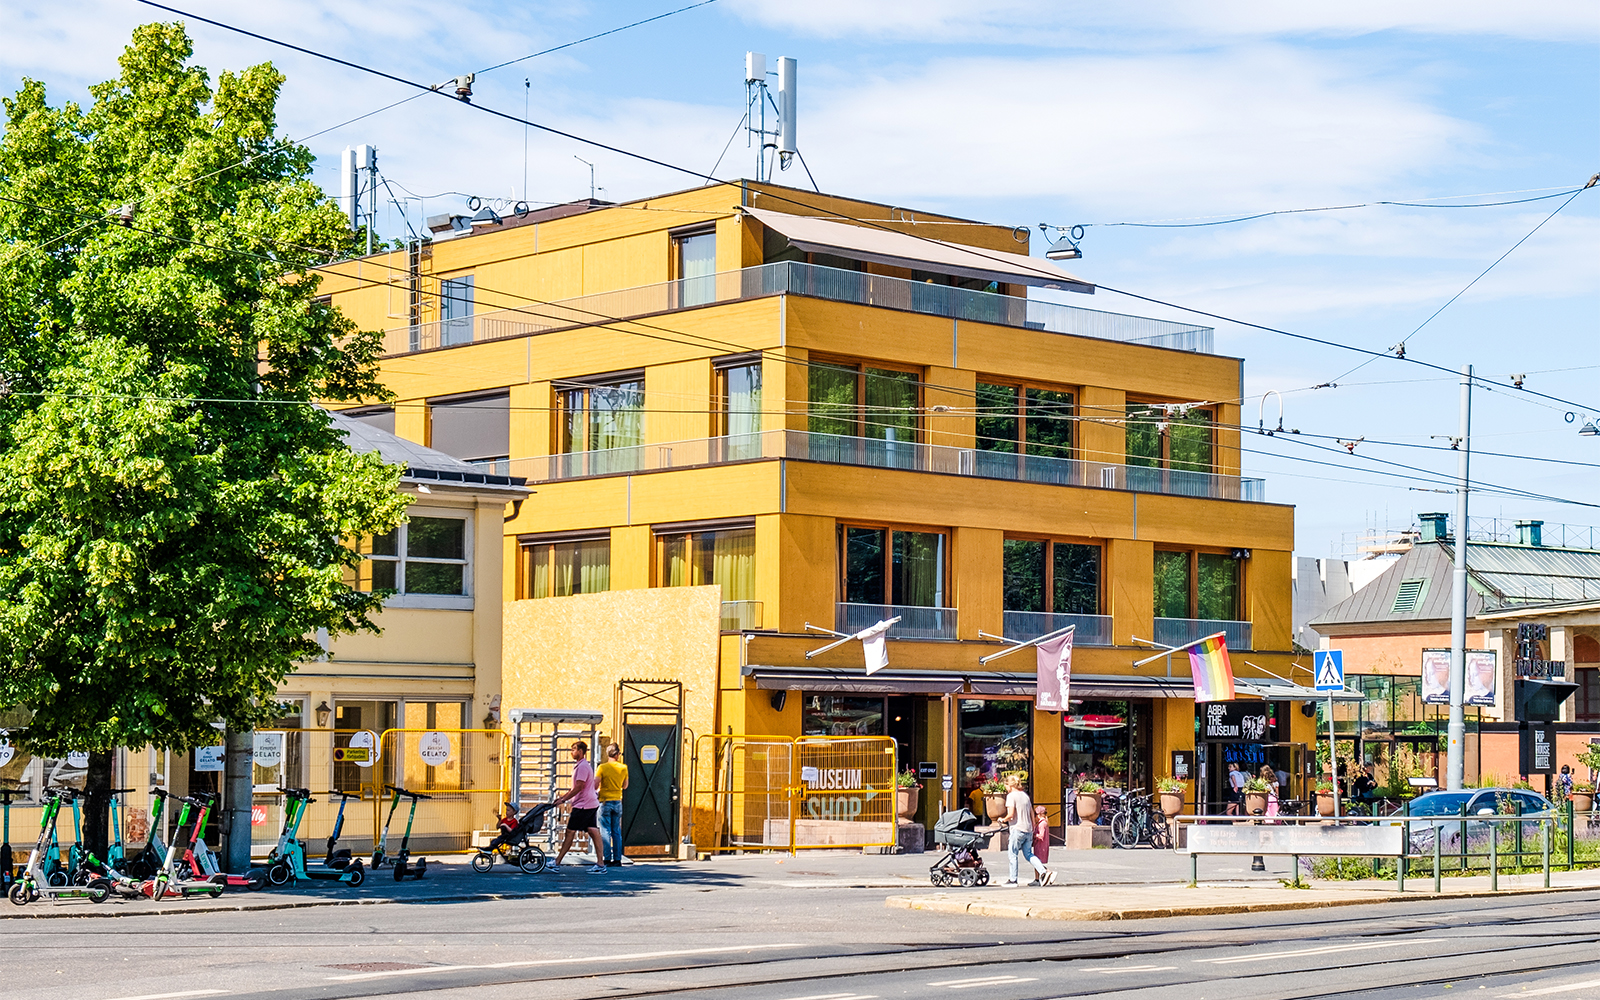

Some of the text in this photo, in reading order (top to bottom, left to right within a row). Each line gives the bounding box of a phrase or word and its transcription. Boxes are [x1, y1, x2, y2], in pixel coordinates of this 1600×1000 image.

[1516, 659, 1565, 677] MUSEUM
[1207, 704, 1227, 715] ABBA
[1207, 715, 1222, 725] THE
[1207, 725, 1239, 736] MUSEUM
[1536, 744, 1550, 755] HOUSE
[808, 796, 862, 821] SHOP
[251, 808, 267, 824] lly
[1210, 829, 1219, 837] Till
